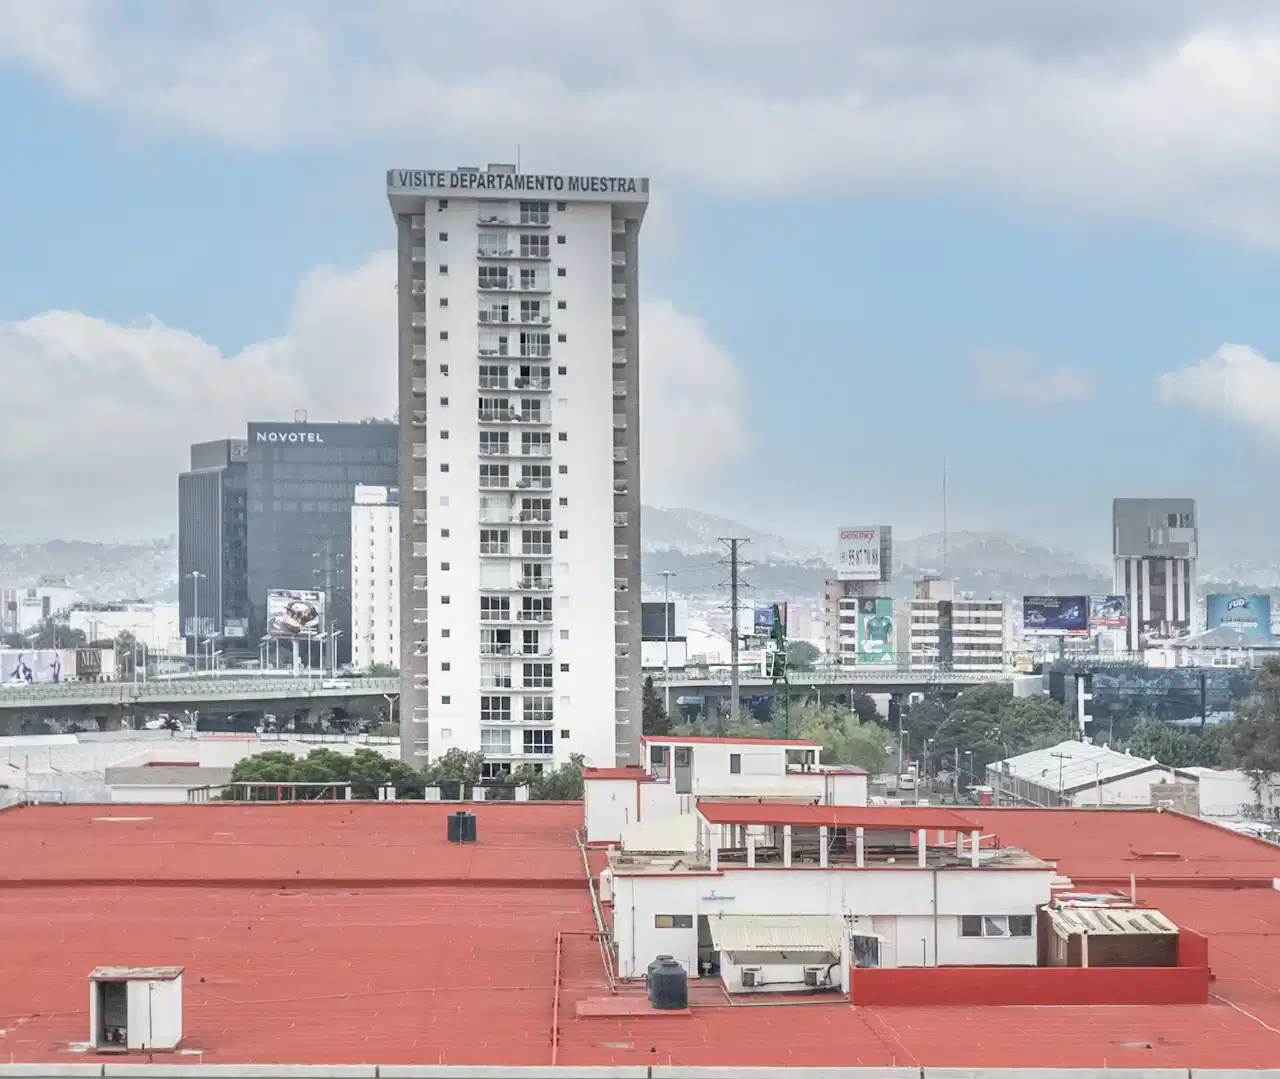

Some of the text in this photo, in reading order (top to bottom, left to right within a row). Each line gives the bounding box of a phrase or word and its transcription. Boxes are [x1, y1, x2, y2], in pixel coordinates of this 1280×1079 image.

[398, 171, 637, 193] VISITE DEPARTAMENTO MUESTRA
[256, 431, 324, 443] NOVOTEL
[1228, 599, 1245, 610] FUD
